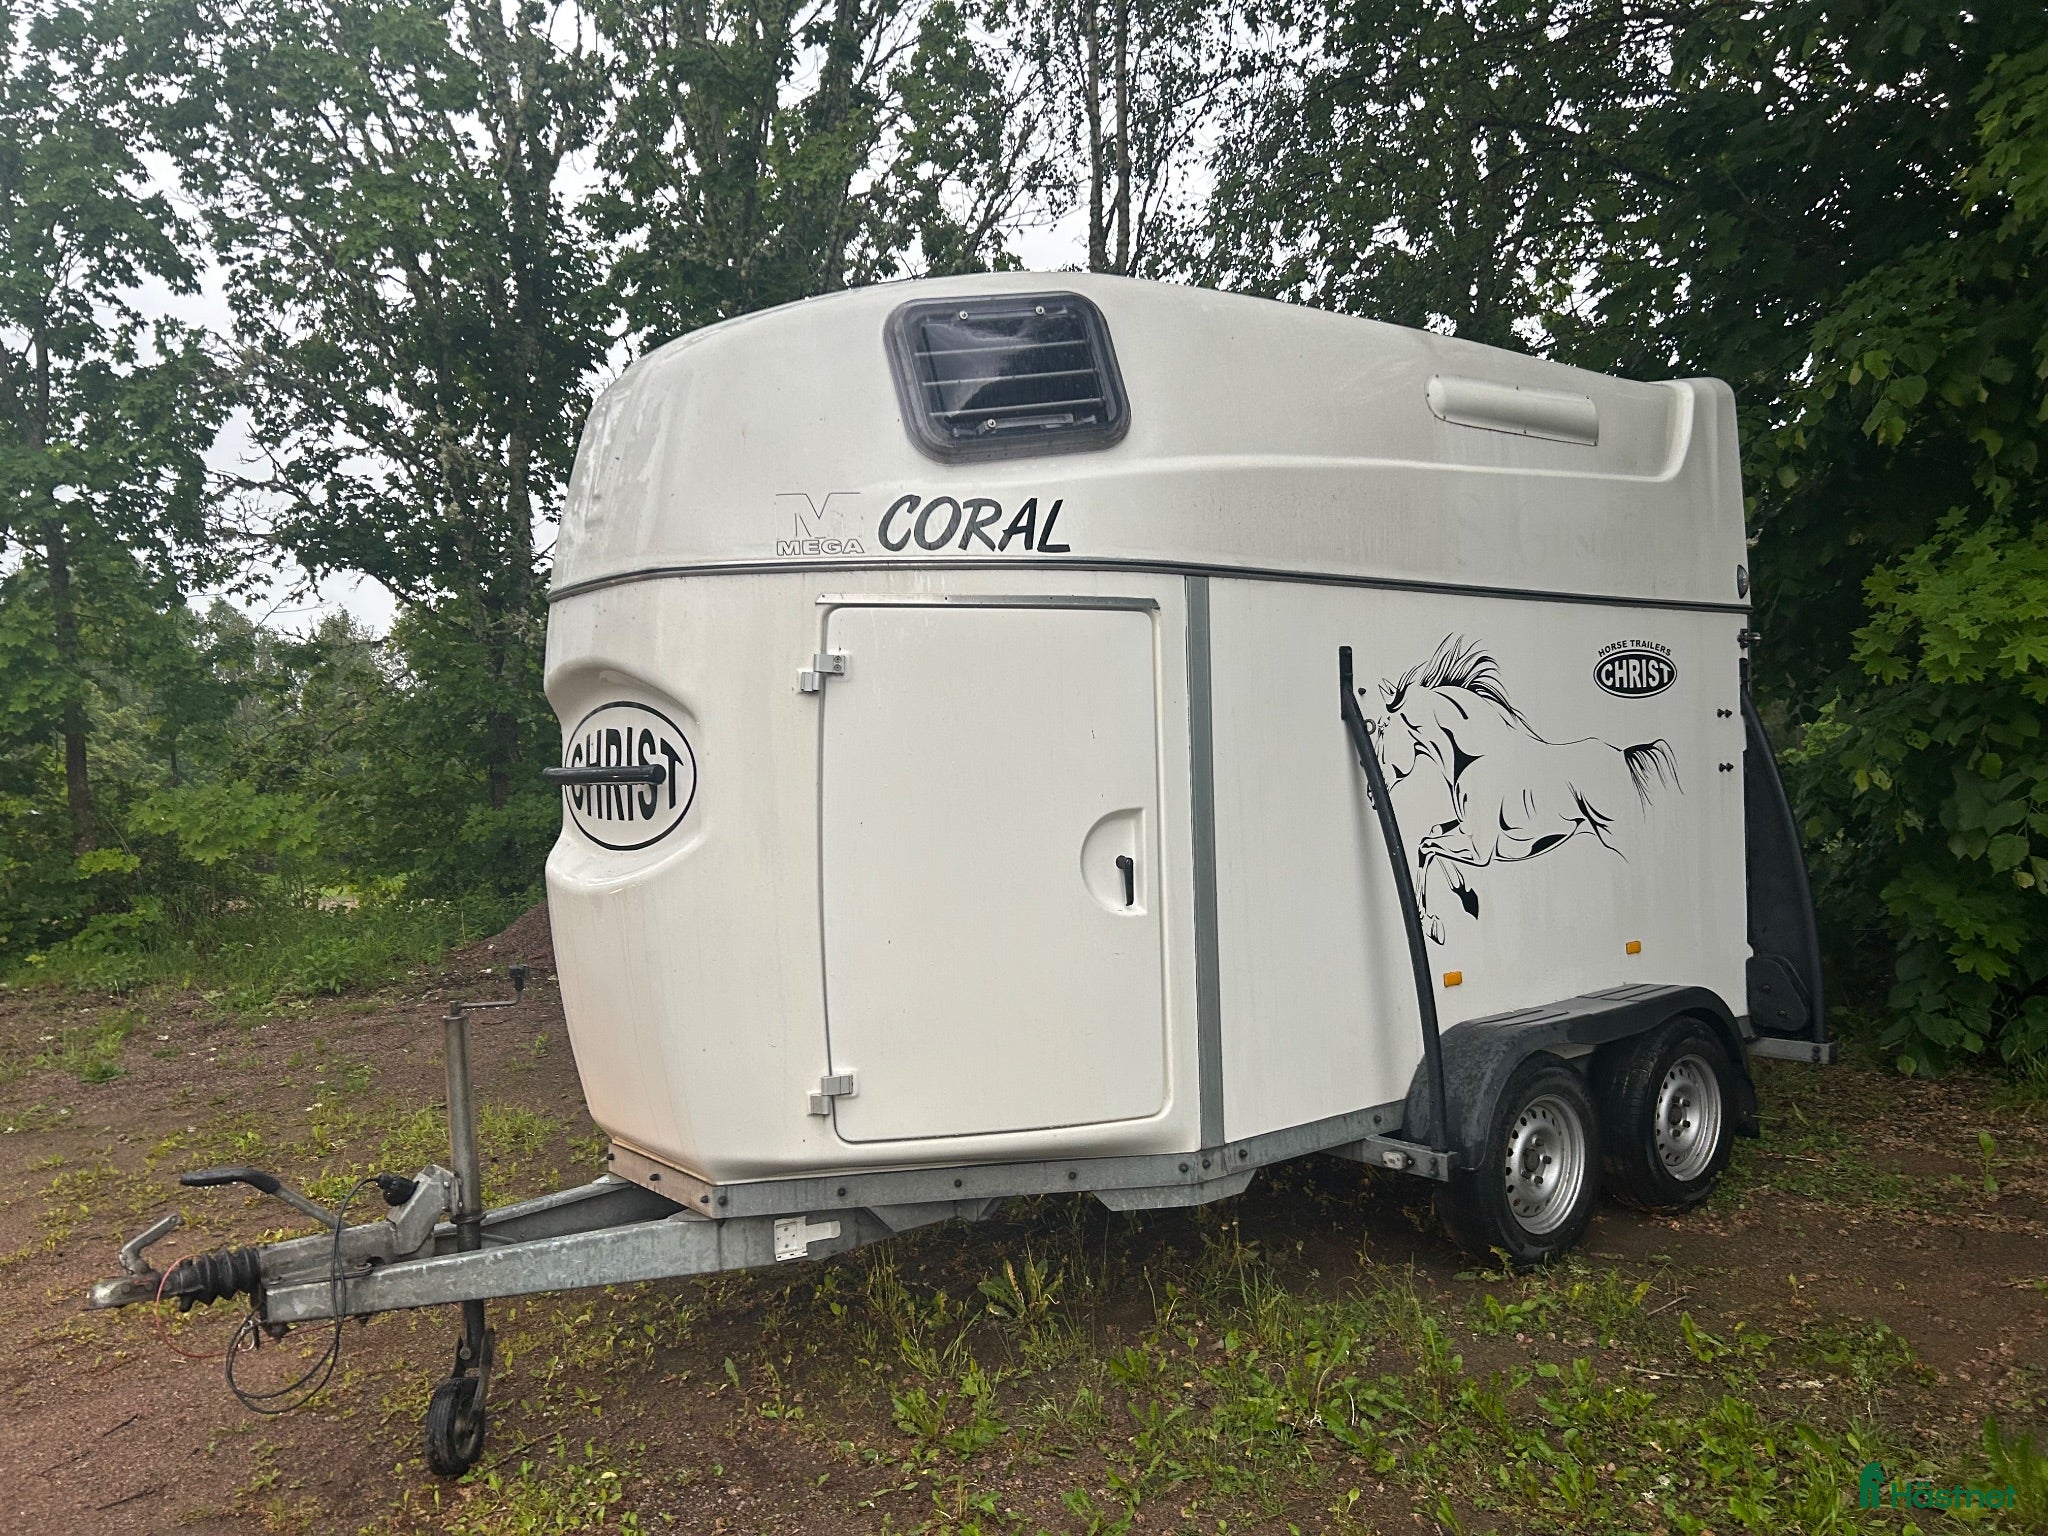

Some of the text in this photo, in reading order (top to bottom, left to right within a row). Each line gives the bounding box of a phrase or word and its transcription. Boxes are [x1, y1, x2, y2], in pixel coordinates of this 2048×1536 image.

[776, 494, 1070, 557] MEGA CORAL
[1598, 639, 1672, 657] HORSE TRAILERS
[1600, 658, 1672, 688] CHRIST
[571, 726, 684, 821] CHRIST
